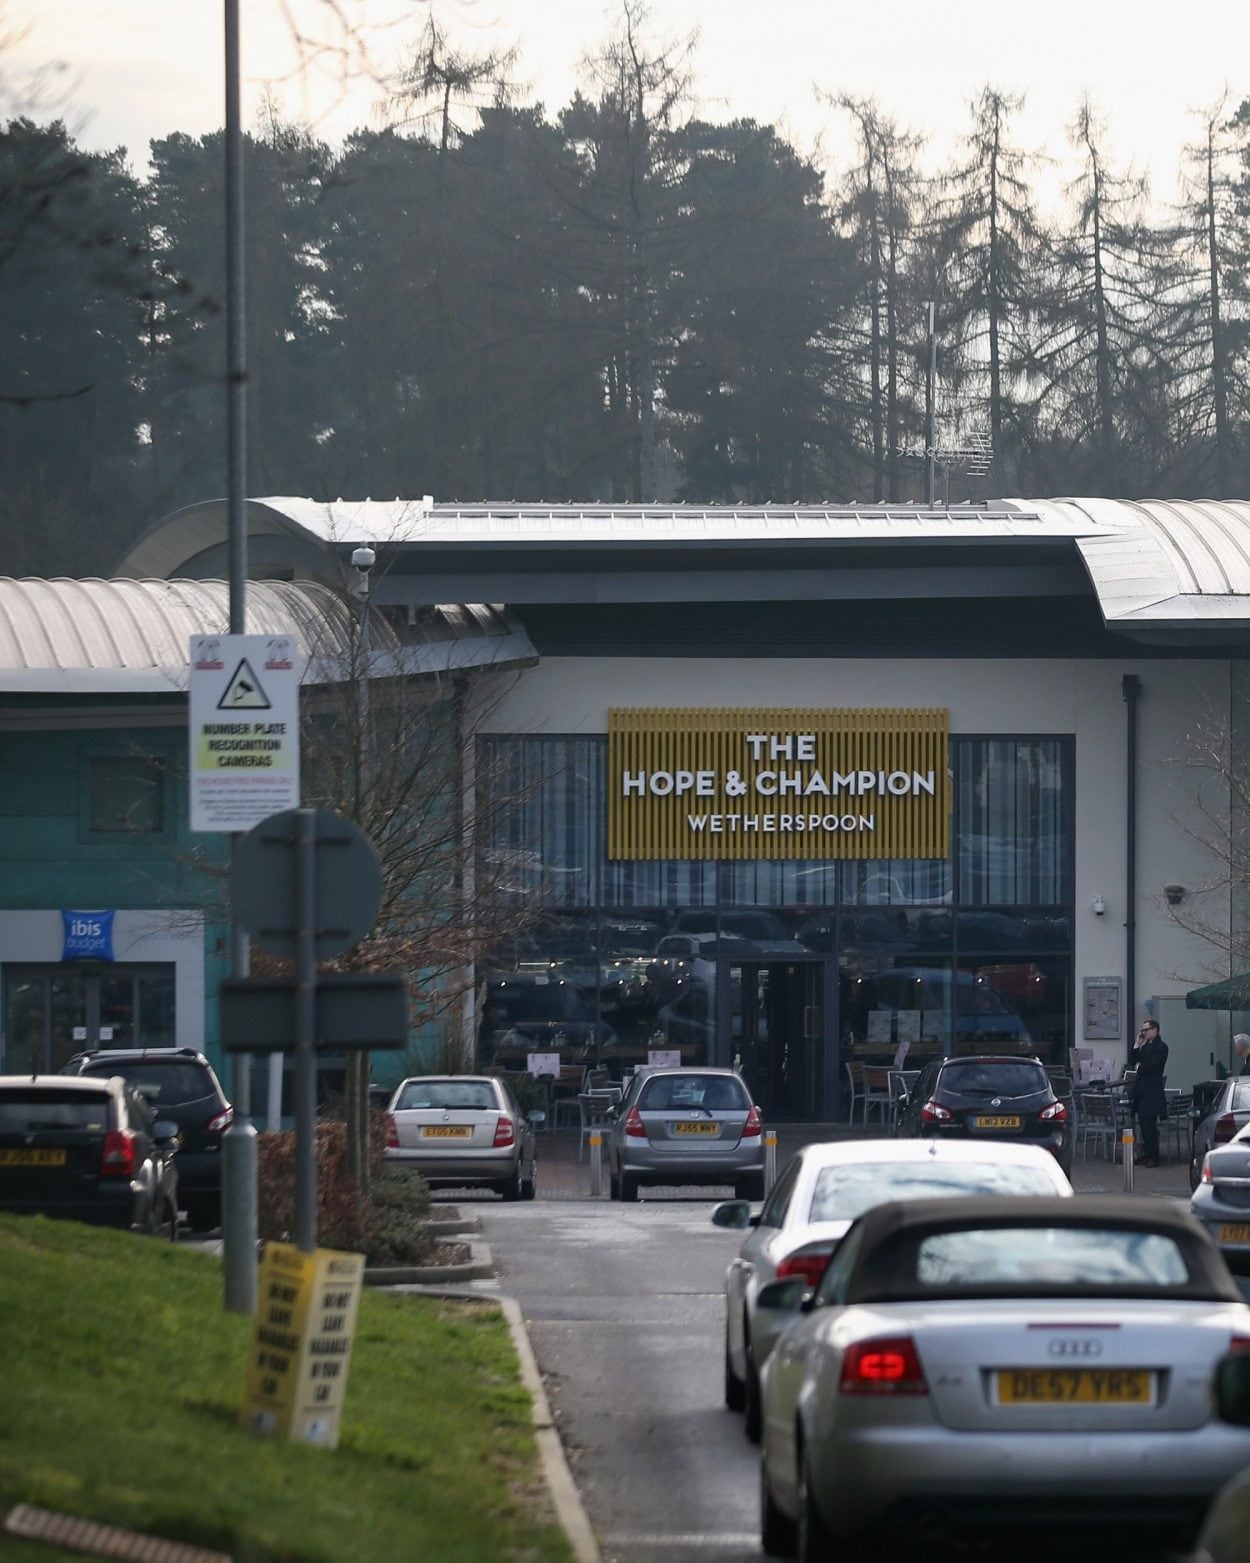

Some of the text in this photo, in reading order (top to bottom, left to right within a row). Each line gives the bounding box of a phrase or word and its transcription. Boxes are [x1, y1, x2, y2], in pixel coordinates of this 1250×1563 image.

[203, 723, 287, 735] NUMBER PLATE
[208, 739, 282, 751] RECOGNITION
[746, 735, 816, 761] THE
[218, 755, 272, 767] CAMERAS
[623, 769, 935, 797] HOPE & CHAMPION
[688, 814, 875, 832] WETHERSPOON
[71, 919, 102, 936] ibis
[68, 937, 107, 951] budget
[1011, 1370, 1142, 1399] DE57 YRS
